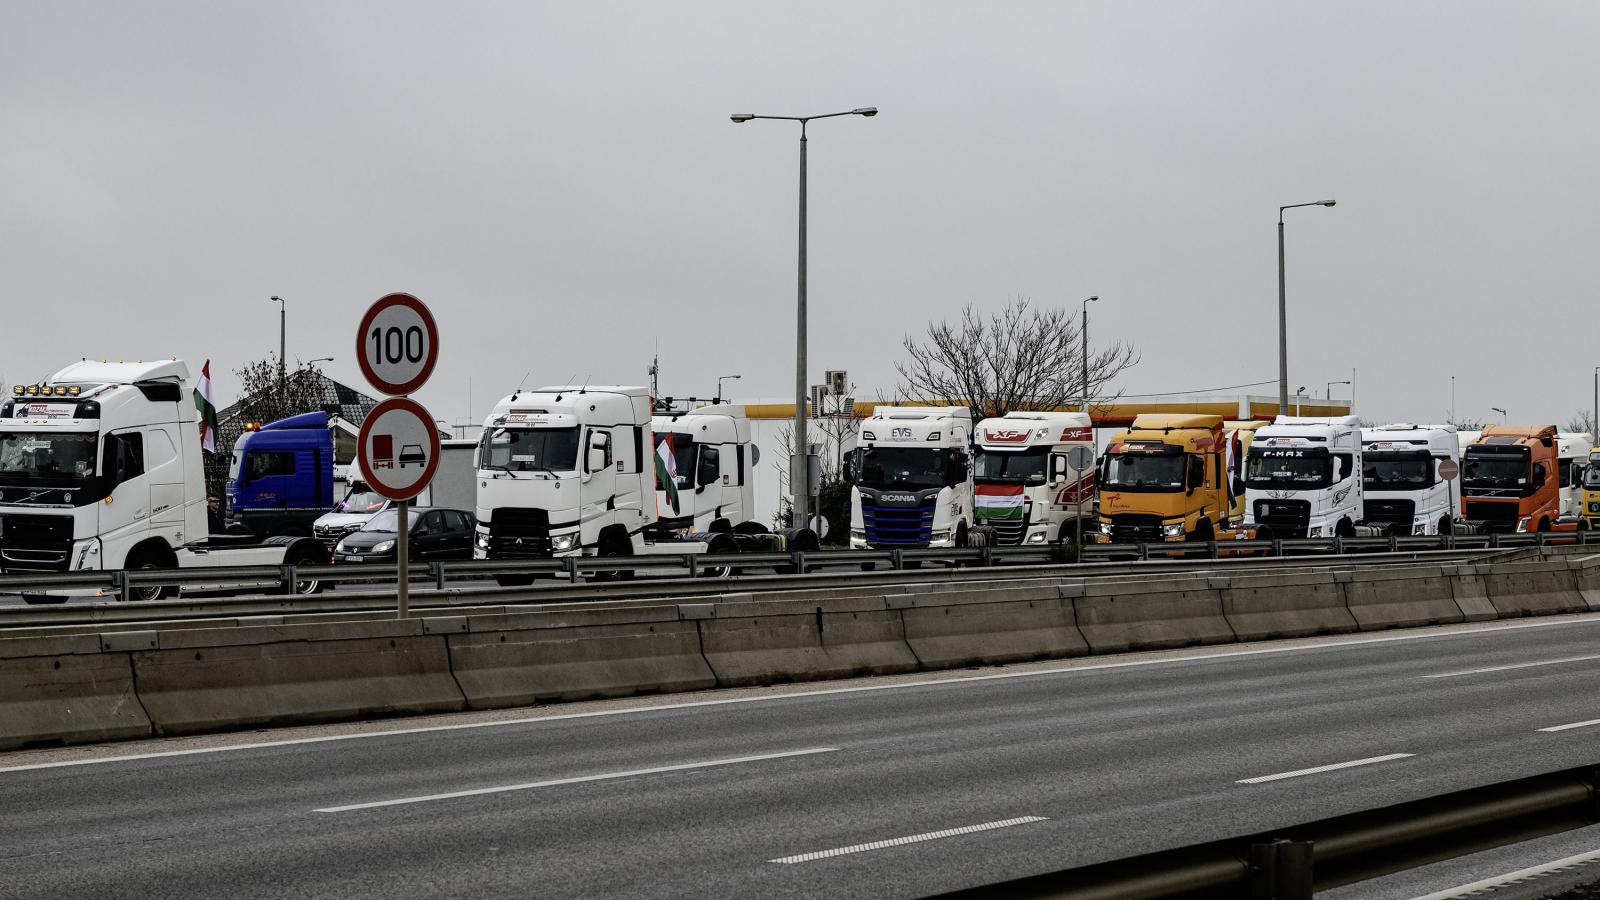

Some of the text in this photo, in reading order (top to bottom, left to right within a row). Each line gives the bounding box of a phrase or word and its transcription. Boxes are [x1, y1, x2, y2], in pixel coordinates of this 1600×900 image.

[371, 325, 424, 365] 100
[892, 427, 912, 437] EVS
[993, 430, 1019, 439] XF
[1070, 430, 1083, 438] XF
[880, 494, 916, 502] SCANIA
